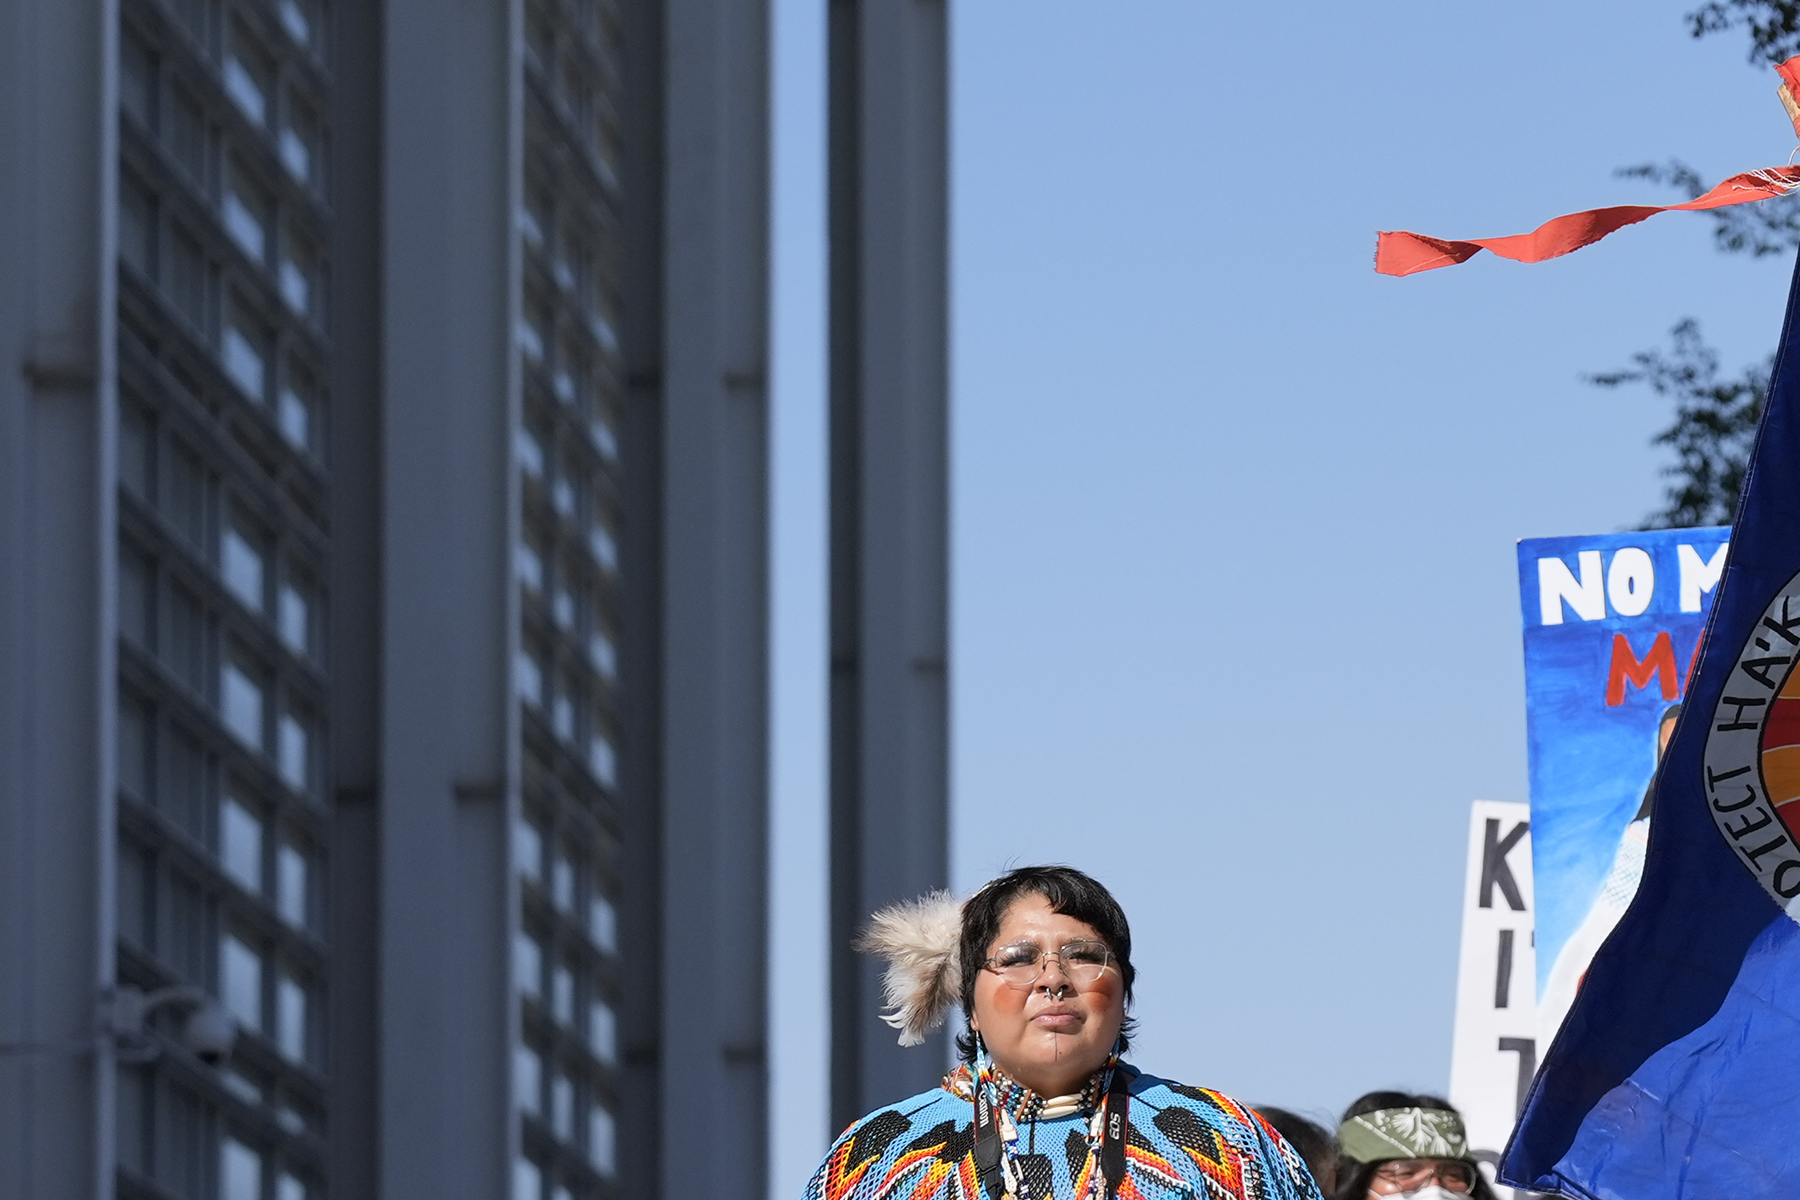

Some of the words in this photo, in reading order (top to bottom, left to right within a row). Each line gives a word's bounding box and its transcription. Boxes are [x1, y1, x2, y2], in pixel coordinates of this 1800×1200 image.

[1537, 546, 1655, 626] NO
[978, 1088, 989, 1128] Canon
[1109, 1111, 1121, 1140] EOS
